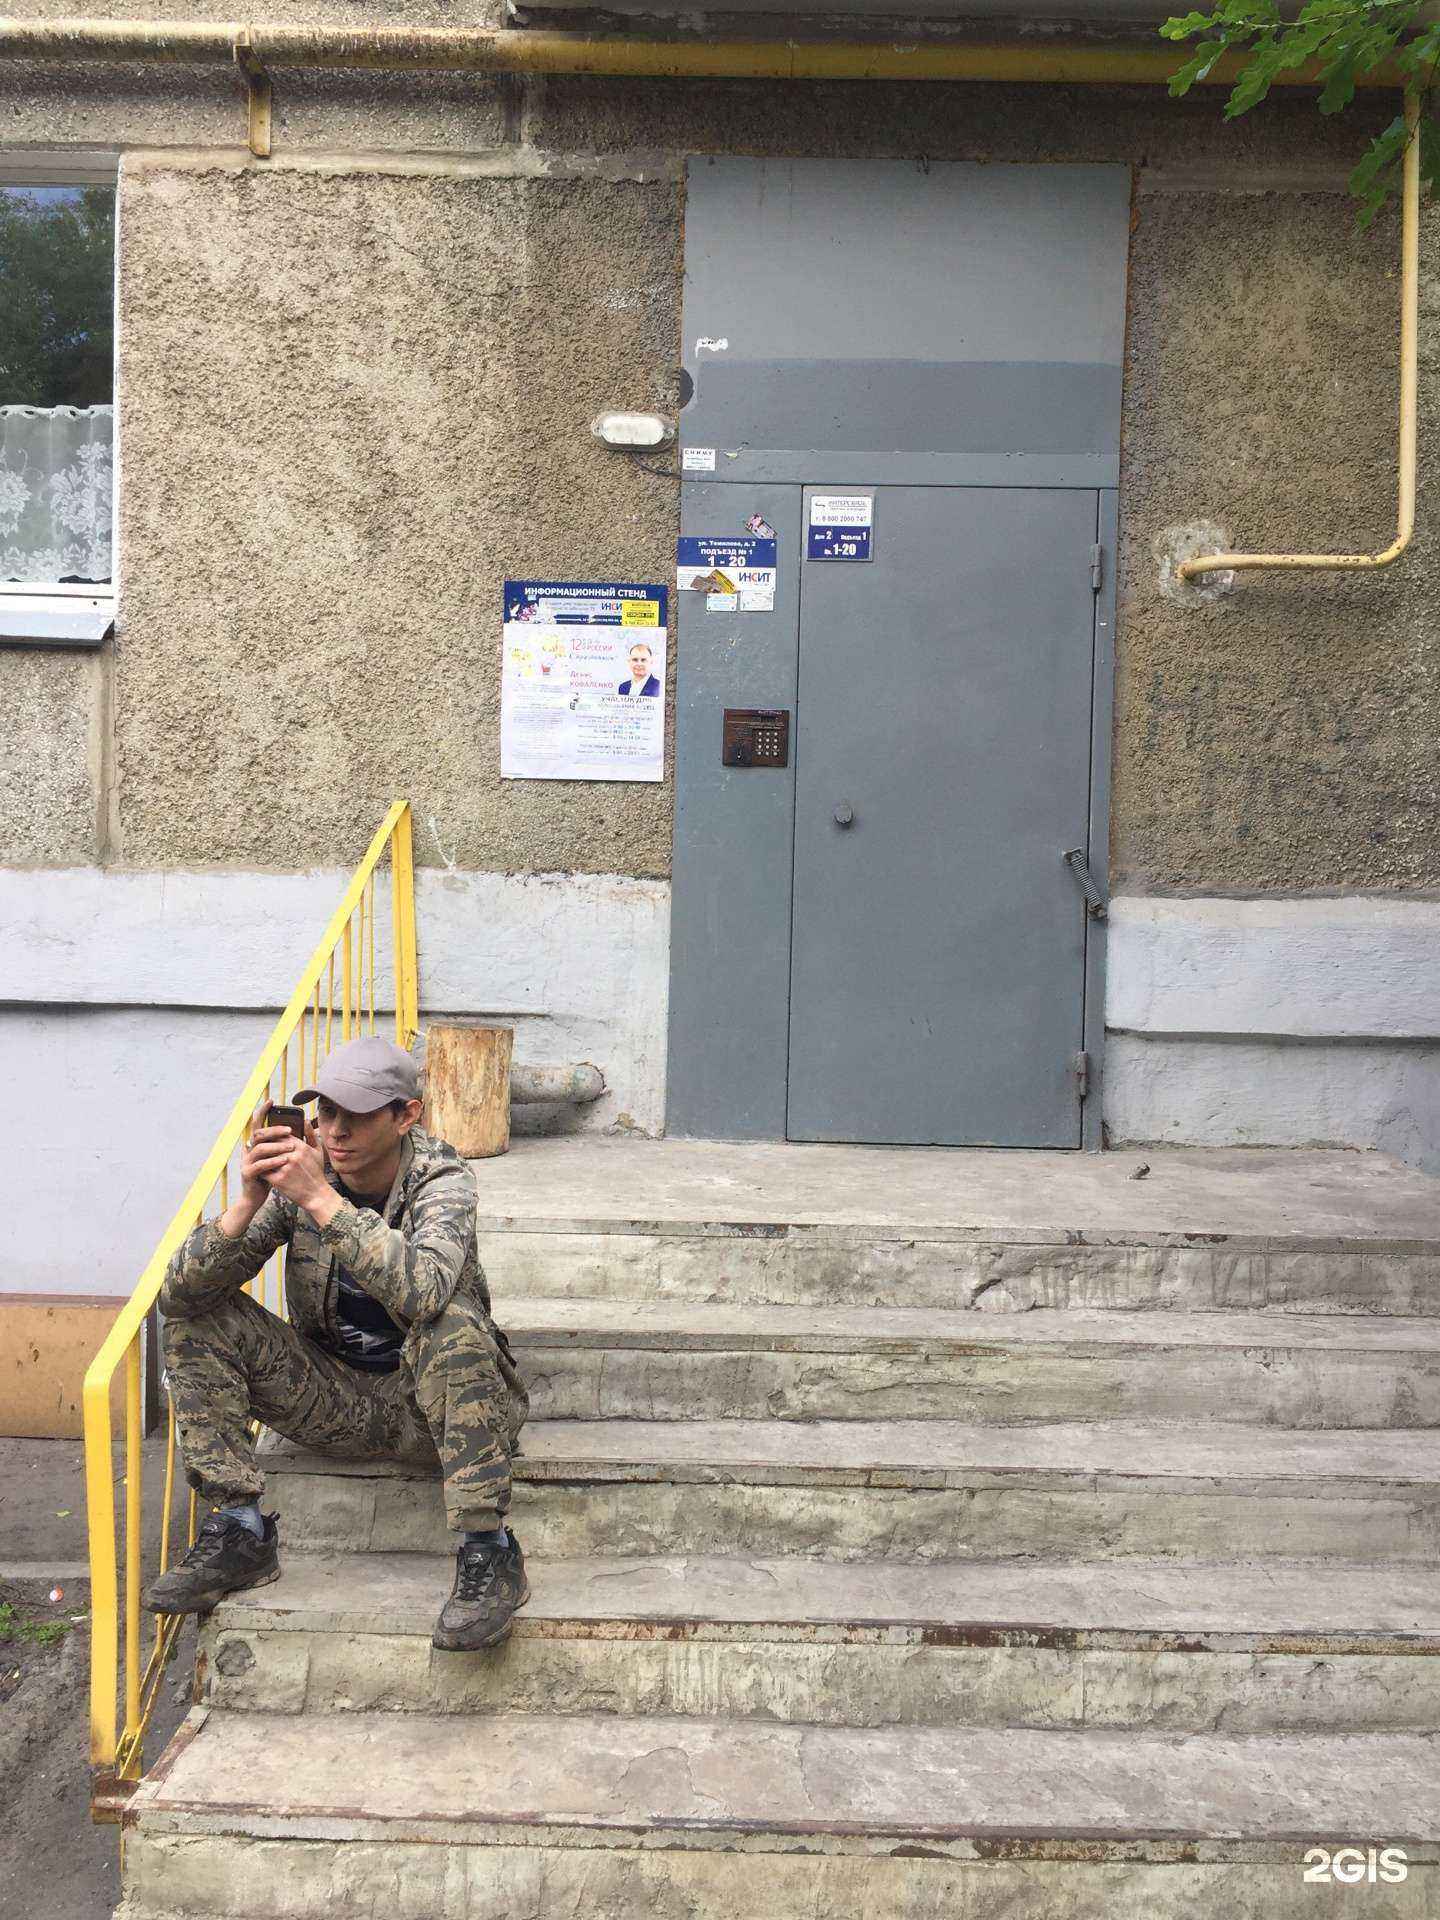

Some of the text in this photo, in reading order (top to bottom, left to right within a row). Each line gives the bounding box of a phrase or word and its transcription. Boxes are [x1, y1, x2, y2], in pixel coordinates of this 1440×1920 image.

[826, 530, 832, 540] 2
[862, 531, 867, 541] 1
[833, 543, 857, 556] 1-20
[707, 555, 715, 566] 1
[728, 555, 746, 567] 20
[738, 572, 771, 582] ИНСИТ
[524, 587, 647, 599] ИНФОРМАЦИОННЫЙ СТЕНД
[601, 602, 622, 610] ИНСИ
